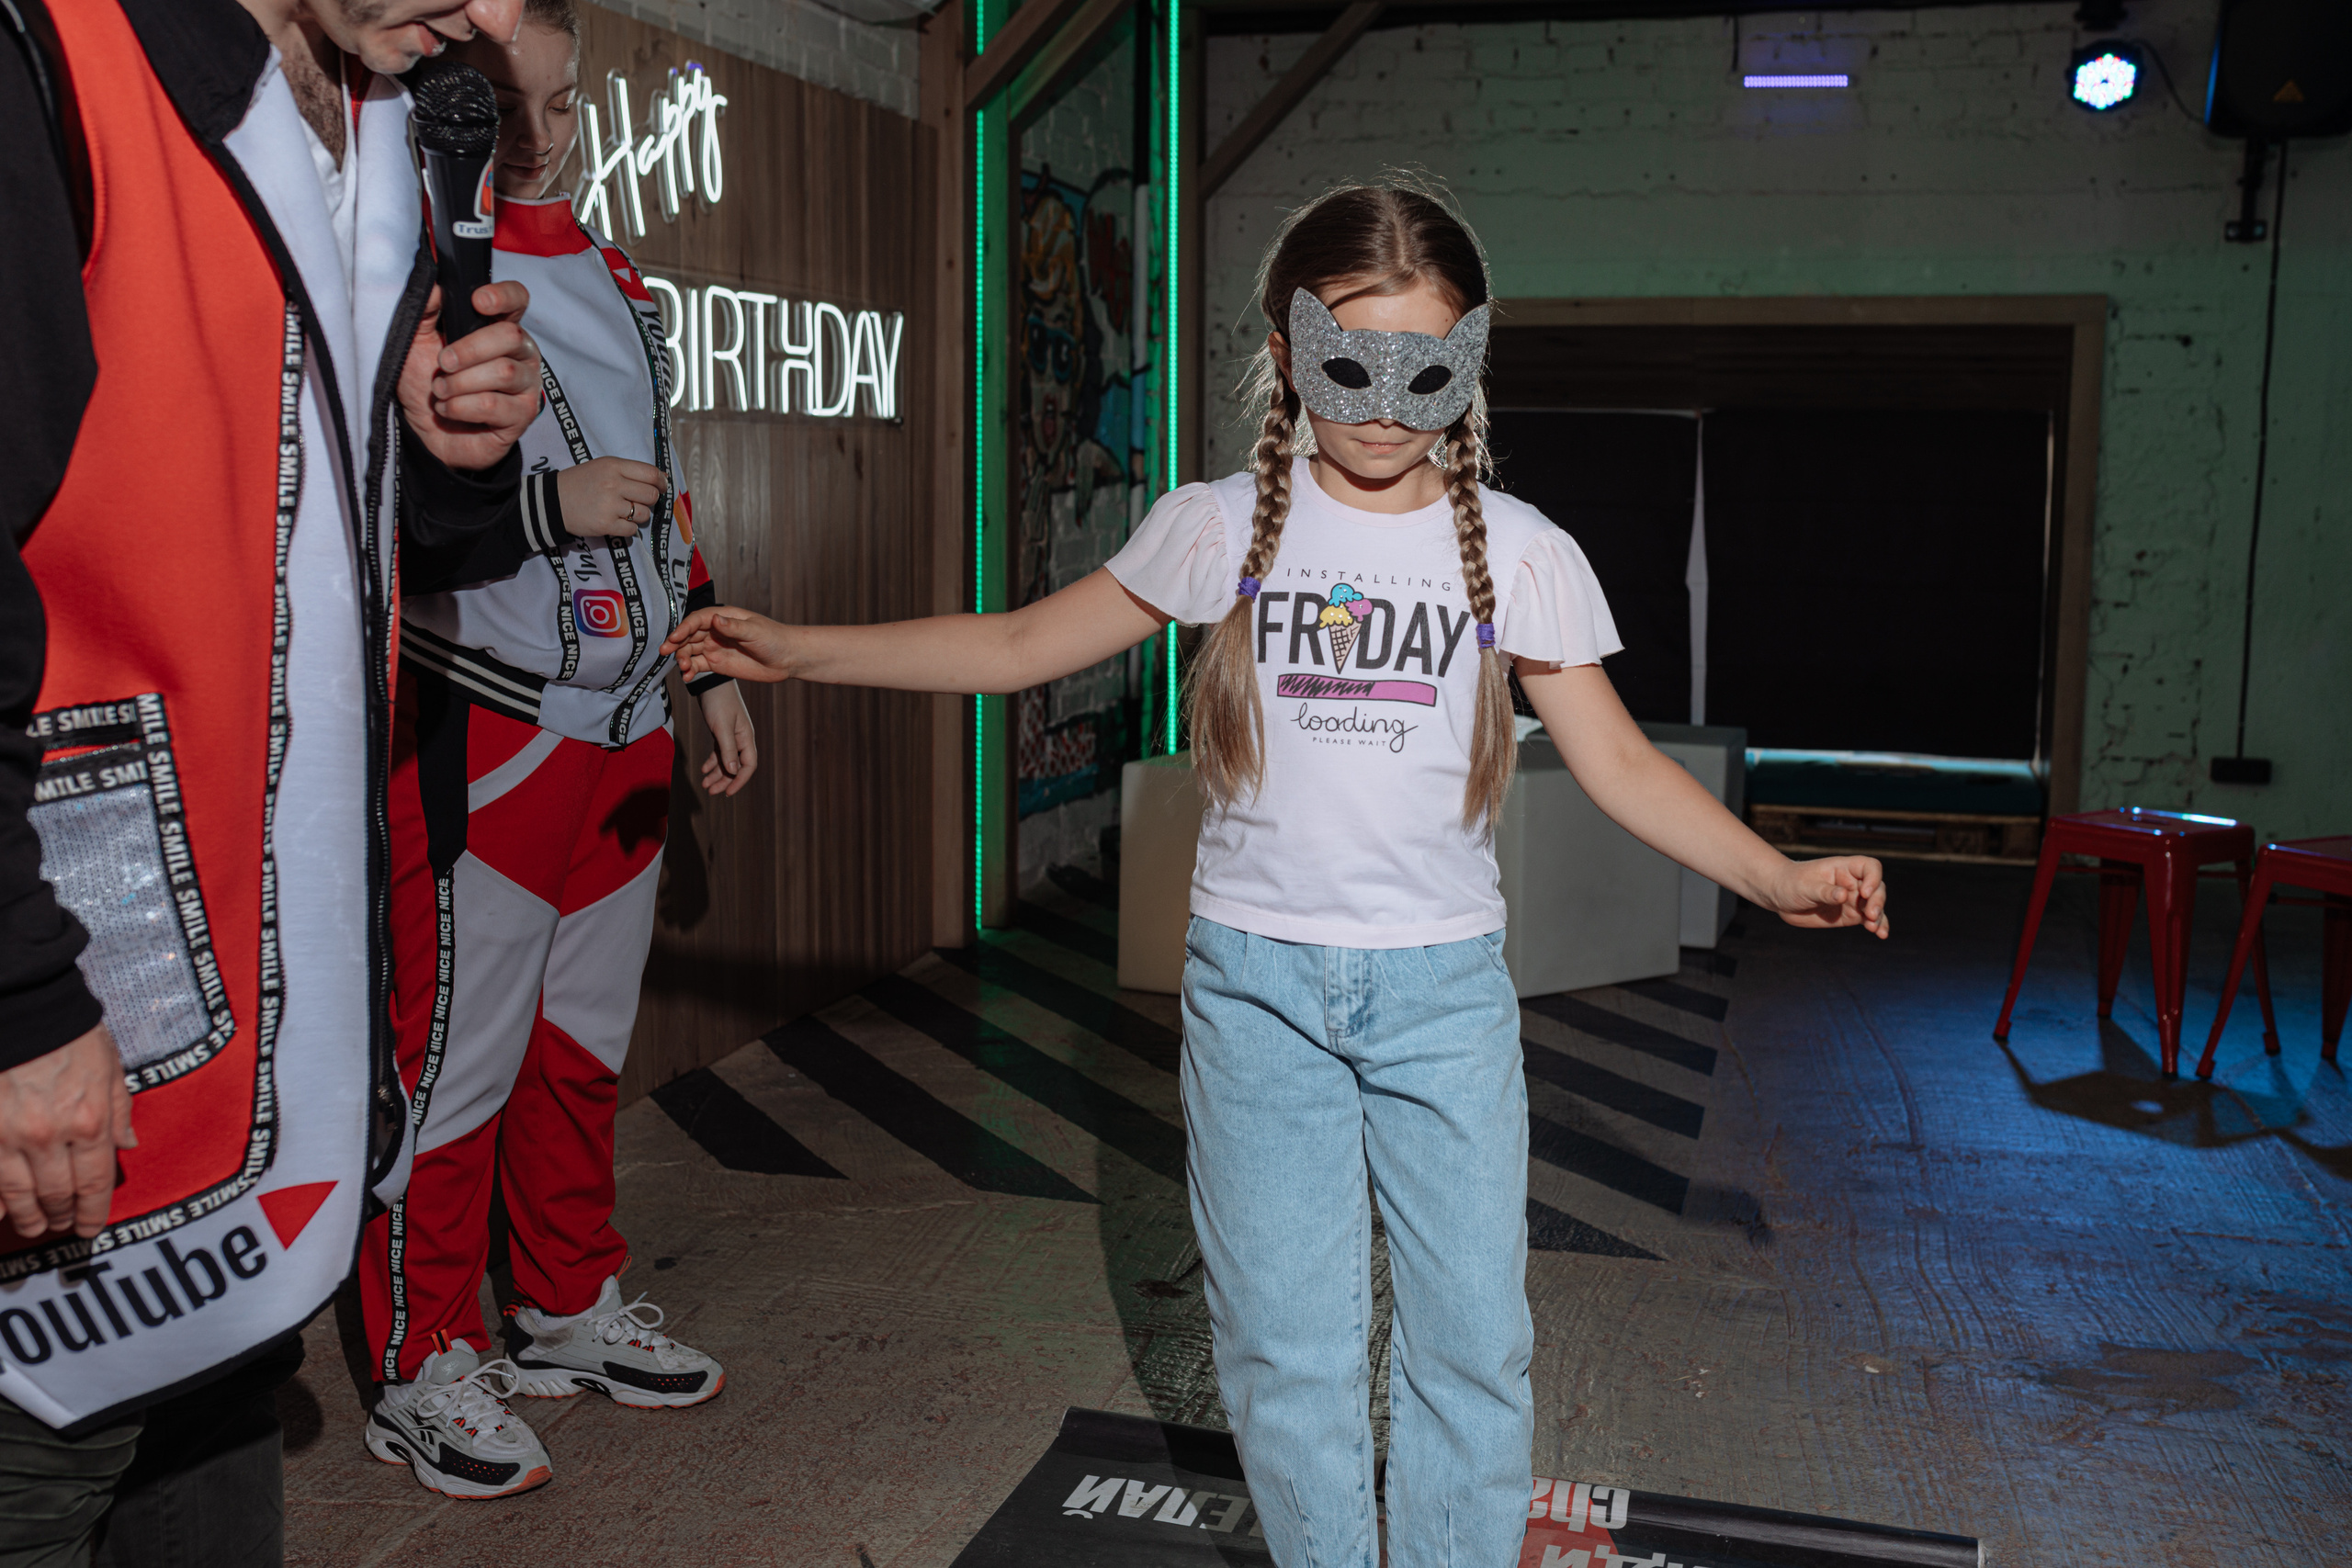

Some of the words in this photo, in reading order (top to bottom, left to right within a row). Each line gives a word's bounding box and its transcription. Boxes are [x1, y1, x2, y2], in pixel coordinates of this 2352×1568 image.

[580, 67, 728, 242] Happy
[643, 276, 904, 419] BIRTHDAY
[281, 371, 300, 436] SMILE
[555, 401, 579, 440] NICE
[278, 443, 299, 508] SMILE
[659, 524, 671, 559] NICE
[555, 562, 571, 602] NICE
[617, 561, 638, 597] NICE
[1287, 568, 1452, 592] INSTALLING
[560, 605, 576, 641] NICE
[629, 601, 645, 637] NICE
[561, 644, 578, 679] NICE
[625, 641, 645, 672] NICE
[271, 654, 287, 716] SMILE
[618, 708, 631, 744] NICE
[1290, 702, 1419, 753] loading
[1312, 737, 1351, 746] PLEASE
[1358, 739, 1387, 747] WAIT
[267, 724, 287, 785] SMILE
[147, 750, 182, 815] SMILE
[159, 821, 195, 886] SMILE
[262, 861, 276, 922] SMILE
[438, 877, 450, 910] NICE
[175, 888, 210, 949] SMILE
[440, 913, 451, 946] NICE
[261, 928, 279, 991] SMILE
[438, 950, 451, 983] NICE
[193, 950, 226, 1010] SMILE
[435, 985, 449, 1020] NICE
[259, 996, 279, 1056] SMILE
[430, 1022, 445, 1054] NICE
[141, 1043, 211, 1085] SMILE
[420, 1054, 439, 1089] NICE
[254, 1061, 273, 1124] SMILE
[412, 1090, 426, 1125] NICE
[114, 1207, 186, 1244] SMILE
[391, 1202, 403, 1236] NICE
[390, 1239, 402, 1273] NICE
[0, 1224, 268, 1369] ouTube
[392, 1275, 404, 1308] NICE
[390, 1310, 406, 1346] NICE
[383, 1348, 397, 1380] NICE
